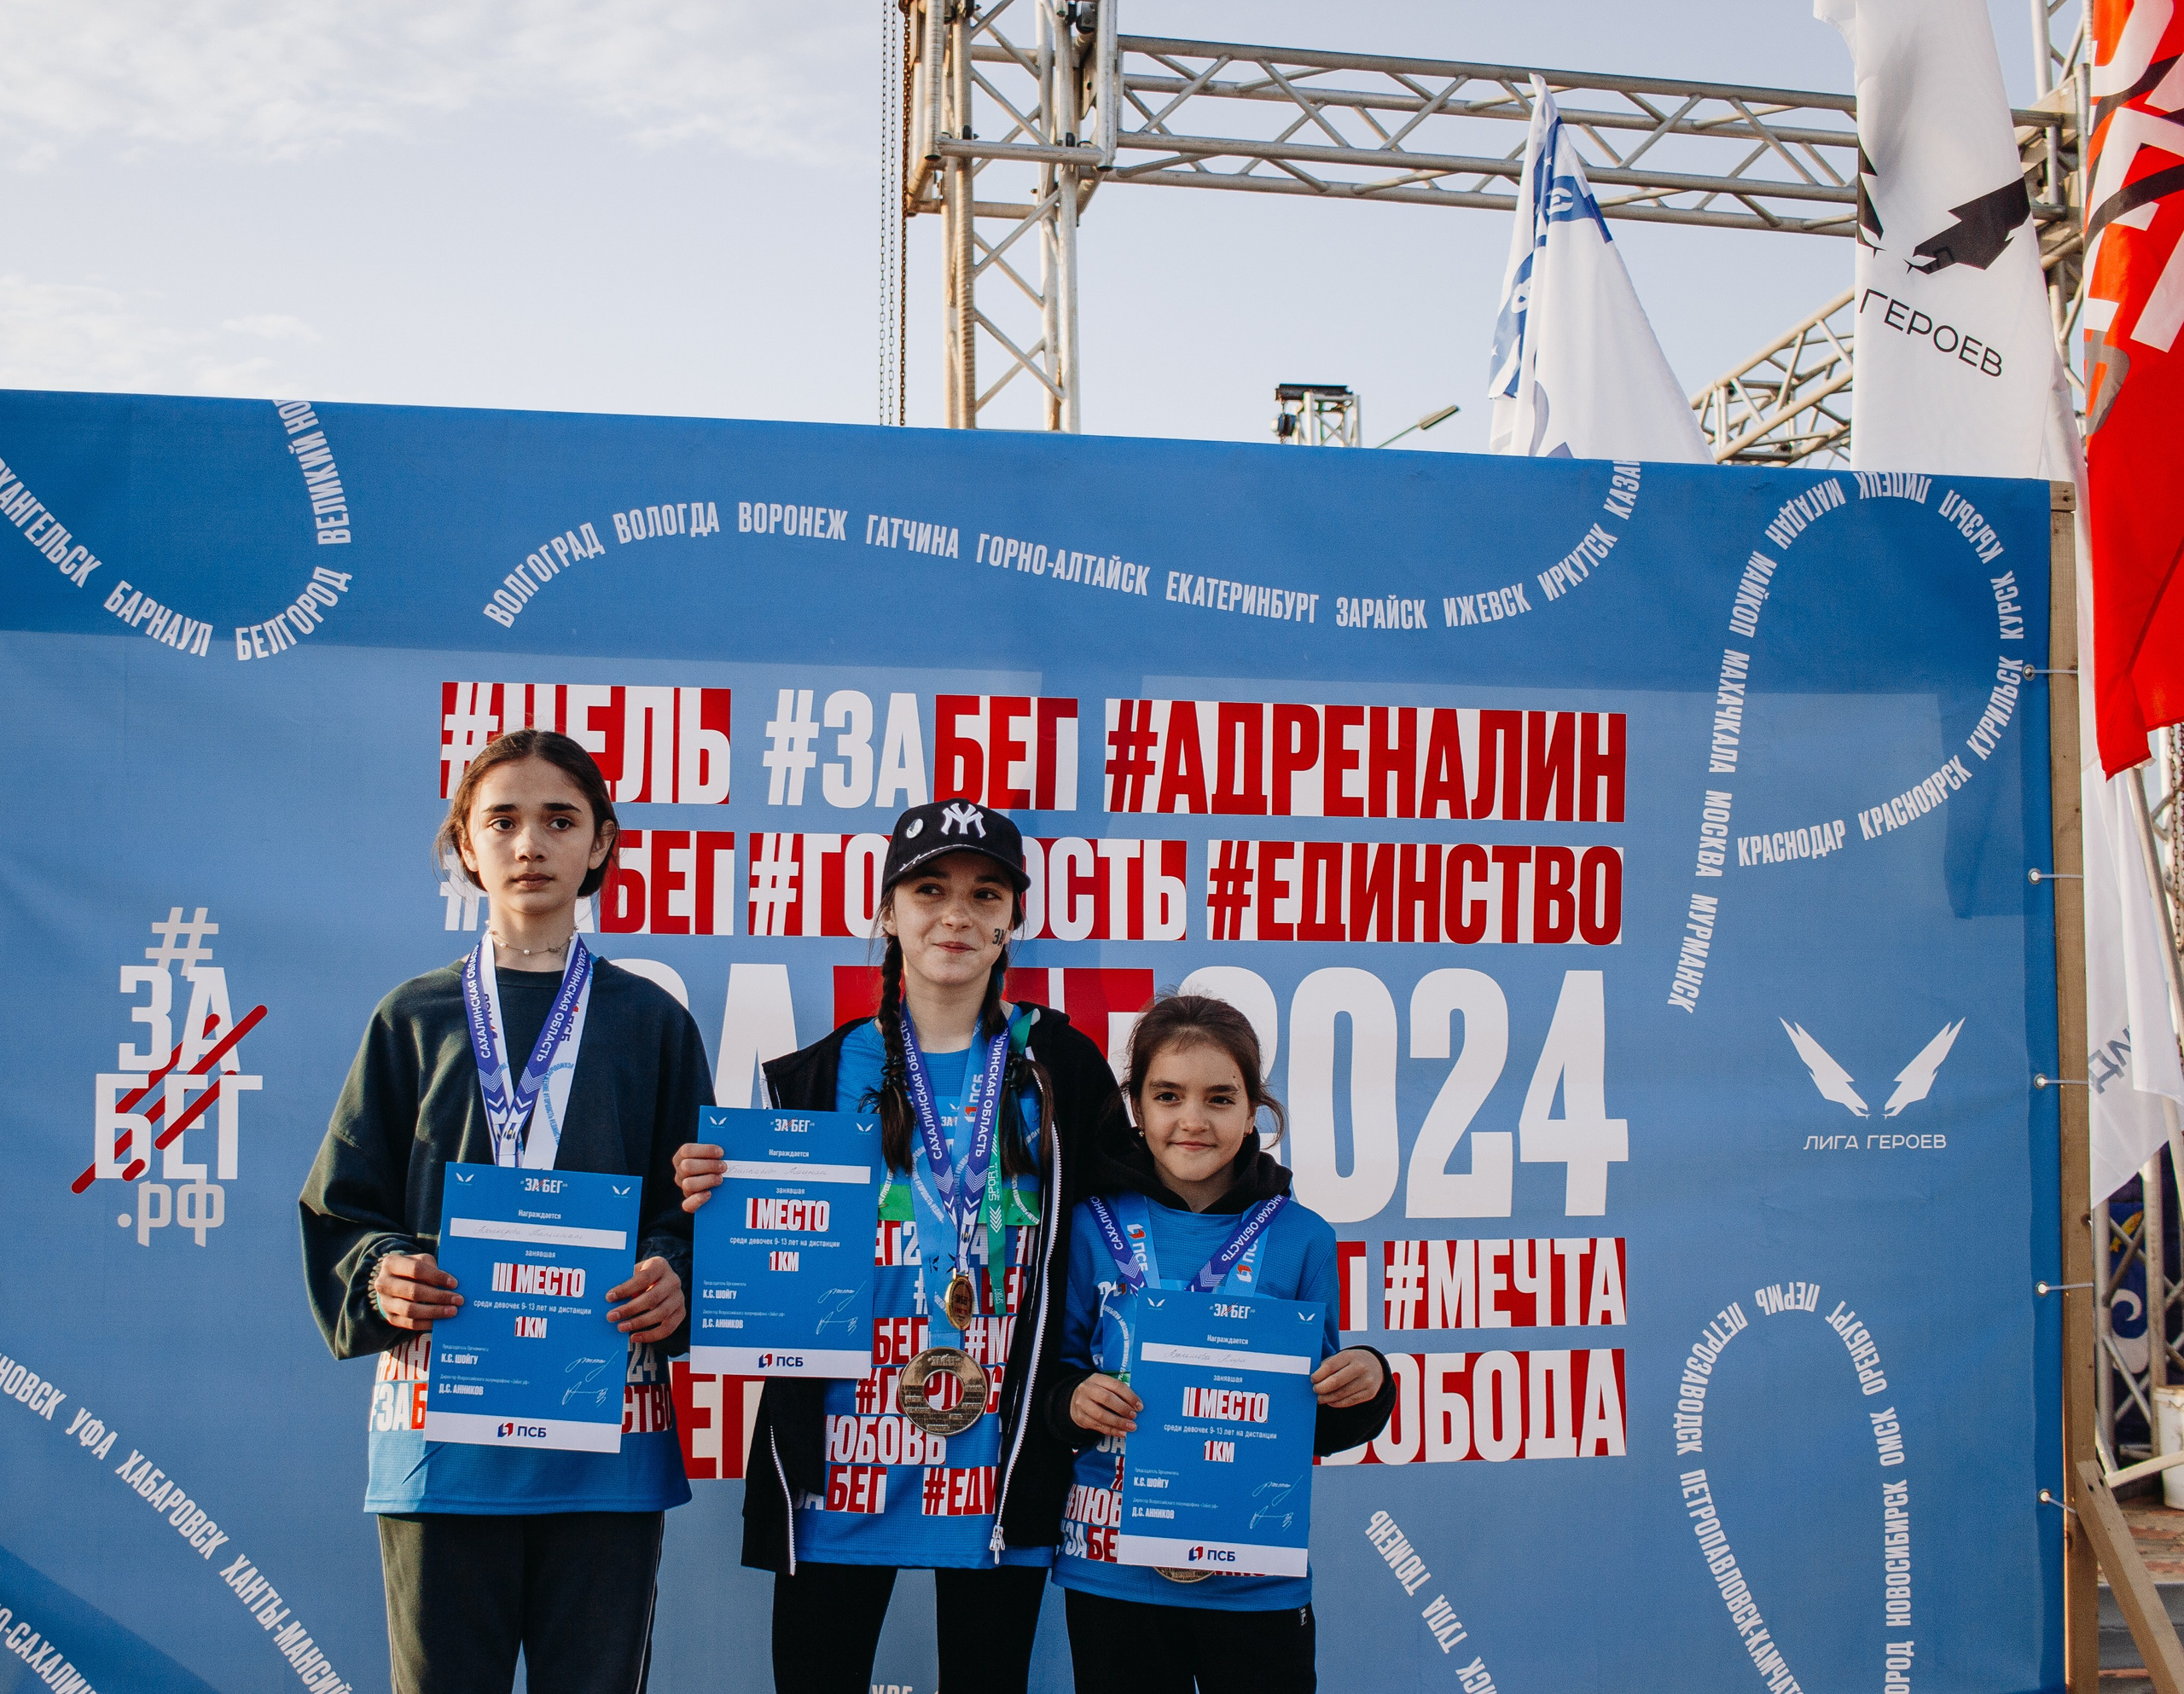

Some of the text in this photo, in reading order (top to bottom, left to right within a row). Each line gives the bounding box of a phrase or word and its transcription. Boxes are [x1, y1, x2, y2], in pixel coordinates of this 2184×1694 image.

[1859, 288, 2003, 378] ГЕРОЕВ
[288, 430, 351, 545] ВЕЛИКИЙ
[0, 457, 102, 589] ХАНГЕЛЬСК
[483, 522, 607, 628] ВОЛГОГРАД
[612, 502, 720, 545] ВОЛОГДА
[738, 502, 848, 541] ВОРОНЕЖ
[865, 514, 960, 559] ГАТЧИНА
[976, 533, 1150, 596] ГОРНО-АЛТАЙСК
[1166, 571, 1319, 624] ЕКАТЕРИНБУРГ
[1336, 595, 1427, 629] ЗАРАЙСК
[1443, 583, 1532, 629] ИЖЕВСК
[1536, 523, 1618, 601] ИРКУТСК
[103, 580, 213, 657] БАРНАУЛ
[235, 566, 352, 661] БЕЛГОРОД
[1105, 699, 1626, 822] #АДРЕНАЛИН
[1667, 471, 2024, 1014] КРАСНОДАР КРАСНОЯРСК КУРИЛЬСК КУРСК КЫЗЫЛ ЛИПЕЦК МАГАДАН МАЙКОП МАХАЧКАЛА МОСКВА МУРМАНСК
[749, 832, 1187, 942] #ГООСТЬ
[1207, 840, 1623, 946] #ЕДИНСТВО
[559, 947, 587, 1012] САХАЛИНСКАЯ
[119, 966, 241, 1072] ЗА
[468, 979, 491, 1059] САХАЛИНСКАЯ
[537, 1012, 565, 1062] ОБЛАСТЬ
[901, 1020, 919, 1071] ОБЛАСТЬ
[95, 1073, 263, 1181] БЕГ
[912, 1073, 942, 1160] САХАЛИНСКАЯ
[975, 1099, 994, 1157] ОБЛАСТЬ
[769, 1149, 810, 1157] Награждается
[1804, 1134, 1947, 1150] ЛИГА ГЕРОЕВ
[988, 1165, 996, 1201] SPORT
[518, 1210, 561, 1220] Награждается
[746, 1198, 831, 1233] I МЕСТО
[729, 1237, 747, 1245] среди
[770, 1251, 799, 1272] 1 КМ
[1222, 1222, 1258, 1262] ОБЛАСТЬ
[492, 1262, 586, 1297] III МЕСТО
[703, 1289, 737, 1300] К.С. ШОЙГУ
[1384, 1238, 1627, 1330] #МЕЧТА
[473, 1301, 492, 1310] среди
[494, 1302, 520, 1311] девочек
[558, 1306, 591, 1314] дистанции
[515, 1316, 548, 1338] 1 КМ
[702, 1319, 743, 1330] Д.С. АННИКОВ
[441, 1354, 479, 1365] К.С. ШОЙГУ
[776, 1356, 804, 1367] ПСБ
[1207, 1335, 1248, 1345] Награждается
[1825, 1301, 1887, 1395] ОРЕНБУРГ
[439, 1384, 484, 1395] Д.С. АННИКОВ
[1213, 1375, 1243, 1384] занявшая
[1182, 1387, 1269, 1423] II МЕСТО
[517, 1426, 547, 1437] ПСБ
[826, 1415, 947, 1465] ЮБОВЬ
[1164, 1424, 1182, 1433] среди
[1183, 1425, 1209, 1434] девочек
[1245, 1430, 1277, 1439] дистанции
[1204, 1441, 1235, 1463] 1 КМ
[1869, 1406, 1905, 1466] ОМСК
[65, 1407, 119, 1460] УФА
[114, 1449, 229, 1560] ХАБАРОВСК
[1134, 1476, 1169, 1488] К.С. ШОЙГУ
[1673, 1281, 1821, 1694] ПЕРМЬ ПЕТРОЗАВОДСК ПЕТРОПАВЛОВСК-КАМЧАТ
[1132, 1507, 1175, 1519] Д.С. АННИКОВ
[1207, 1549, 1235, 1561] ПСБ
[1365, 1510, 1432, 1597] ТЮМЕНЬ
[1883, 1479, 1911, 1627] НОВОСИБИРСК
[1421, 1593, 1467, 1654] ТУЛА
[0, 1608, 98, 1694] О-САХАЛИ
